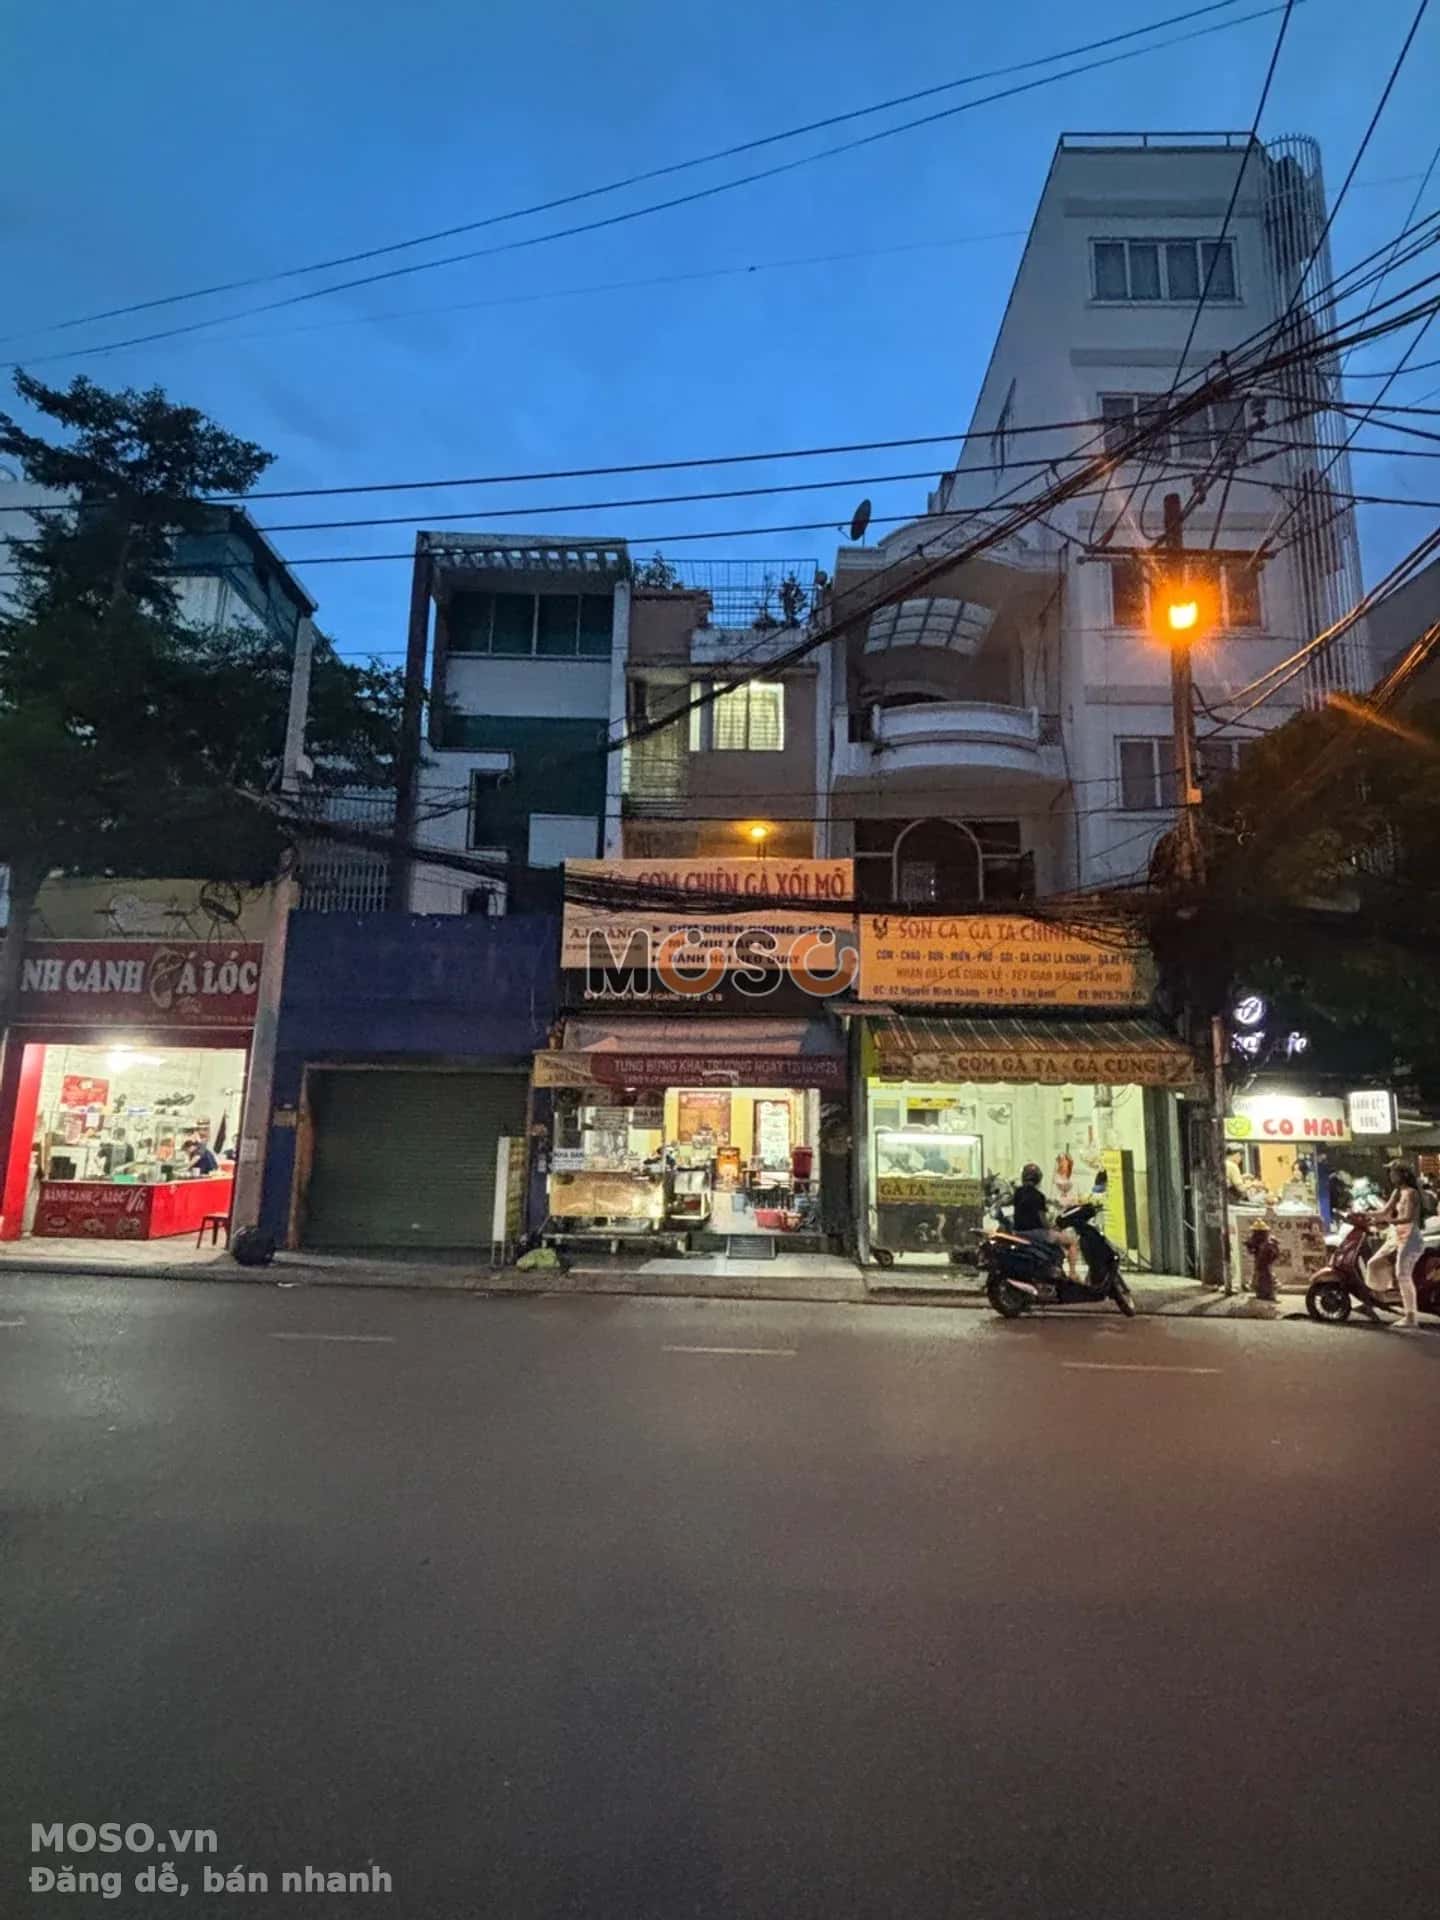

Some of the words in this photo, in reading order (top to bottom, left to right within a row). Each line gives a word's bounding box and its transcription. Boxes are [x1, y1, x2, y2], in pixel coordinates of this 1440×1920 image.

[744, 867, 769, 895] GÀ
[938, 922, 959, 939] CA
[1303, 1118, 1344, 1137] HAI
